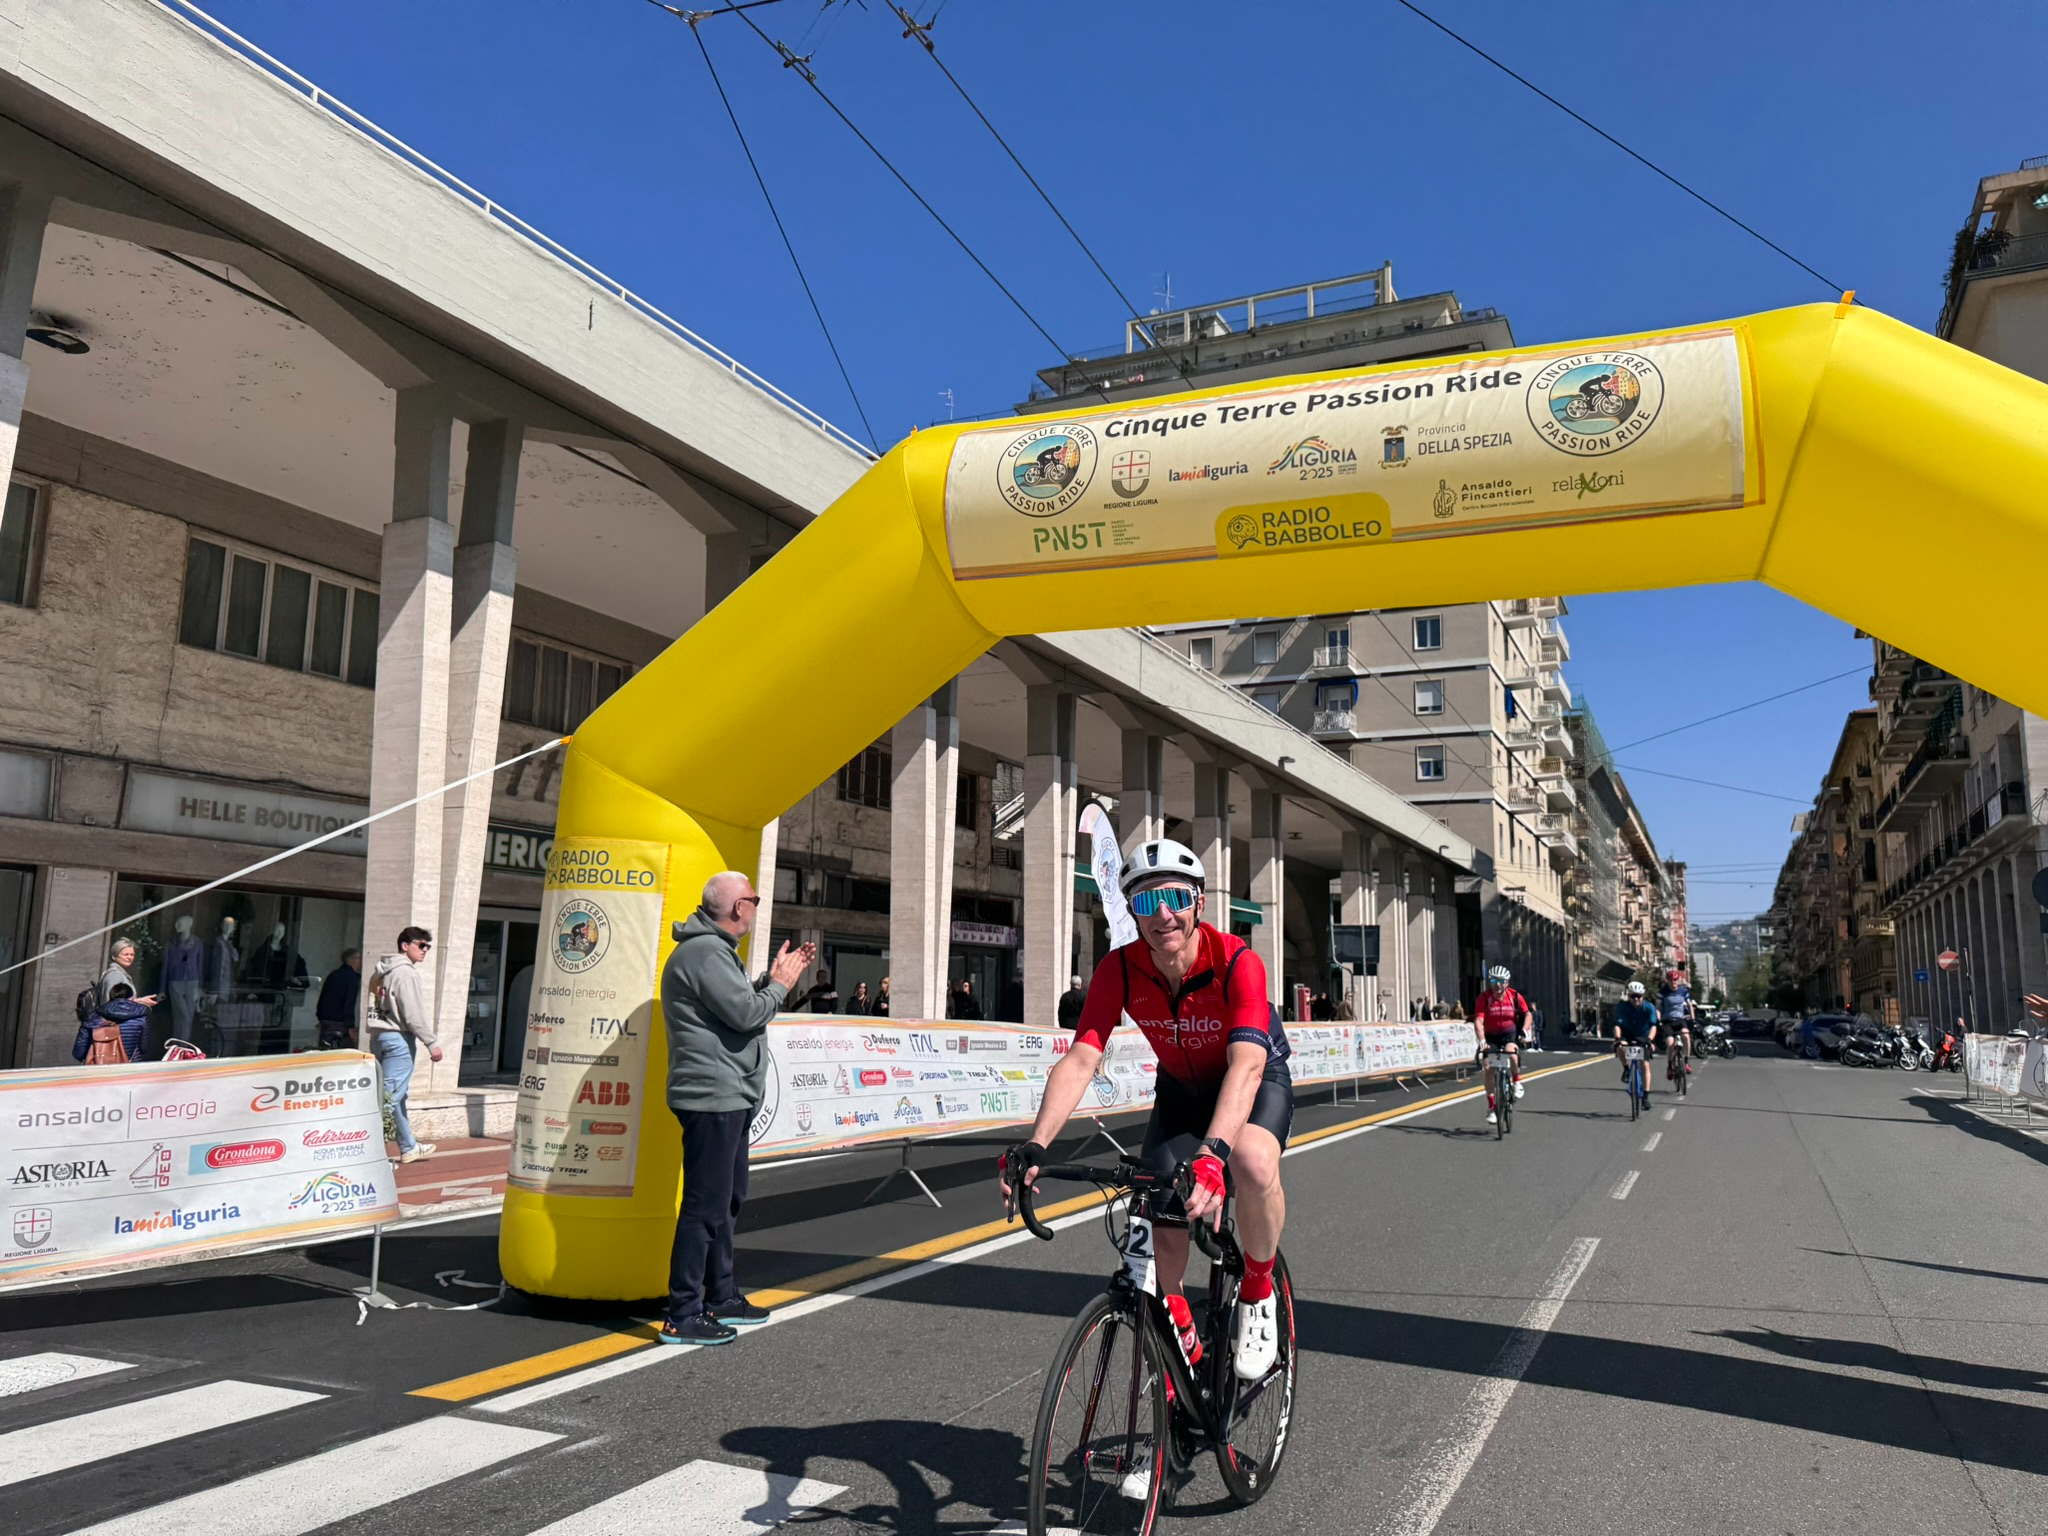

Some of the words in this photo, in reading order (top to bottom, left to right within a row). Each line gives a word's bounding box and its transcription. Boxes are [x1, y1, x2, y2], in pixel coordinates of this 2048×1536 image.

[1536, 355, 1594, 390] CINQUE
[1602, 354, 1653, 377] TERRE
[1105, 412, 1207, 437] Cinque
[1217, 400, 1297, 424] Terre
[1307, 382, 1434, 413] Passion
[1445, 370, 1522, 394] Ride
[1417, 423, 1466, 437] Provincia
[1541, 420, 1611, 451] PASSION
[1616, 409, 1651, 442] RIDE
[1007, 427, 1057, 458] CINQUE
[1062, 426, 1093, 449] TERRE
[1417, 438, 1461, 456] DELLA
[1463, 431, 1513, 451] SPEZIA
[1291, 447, 1357, 469] LIGURIA
[1168, 461, 1249, 482] lamialiguria
[1299, 466, 1334, 481] 2025
[1005, 485, 1055, 513] PASSION
[1058, 478, 1085, 506] RIDE
[1461, 479, 1512, 492] Ansaldo
[1461, 486, 1532, 502] Fincantieri
[1103, 501, 1132, 510] REGIONE
[1132, 498, 1159, 508] LIGURIA
[1262, 506, 1331, 529] RADIO
[1264, 520, 1382, 547] BABBOLEO
[180, 796, 247, 824] HELLE
[561, 850, 610, 866] RADIO
[559, 868, 655, 887] BABBOLEO
[557, 901, 581, 928] CINQUE
[583, 902, 607, 928] TERRE
[554, 949, 580, 970] PASSION
[582, 950, 602, 968] RIDE
[538, 986, 571, 997] ansaldo
[575, 987, 617, 1001] energia
[590, 1017, 638, 1037] ITAL
[786, 1038, 823, 1050] ansaldo
[909, 1033, 939, 1053] ITAL
[1026, 1036, 1043, 1049] ERG
[284, 1076, 371, 1096] Duferco
[524, 1075, 547, 1091] ERG
[576, 1080, 631, 1106] ABB
[18, 1106, 123, 1127] ansaldo
[135, 1099, 217, 1120] energia
[283, 1095, 344, 1111] Energia
[751, 1104, 774, 1136] RIDE
[215, 1144, 276, 1161] Grondona
[313, 1148, 336, 1156] ACQUA
[336, 1143, 365, 1153] MINERALE
[313, 1153, 338, 1162] FONTI
[338, 1149, 365, 1159] BAUDA
[13, 1159, 111, 1185] ASTORIA
[558, 1166, 590, 1174] TREK
[312, 1182, 377, 1203] LIGURIA
[321, 1200, 355, 1213] 2025
[114, 1202, 241, 1234] lamialiguria
[4, 1250, 32, 1259] REGIONE
[33, 1247, 59, 1255] LIGURIA
